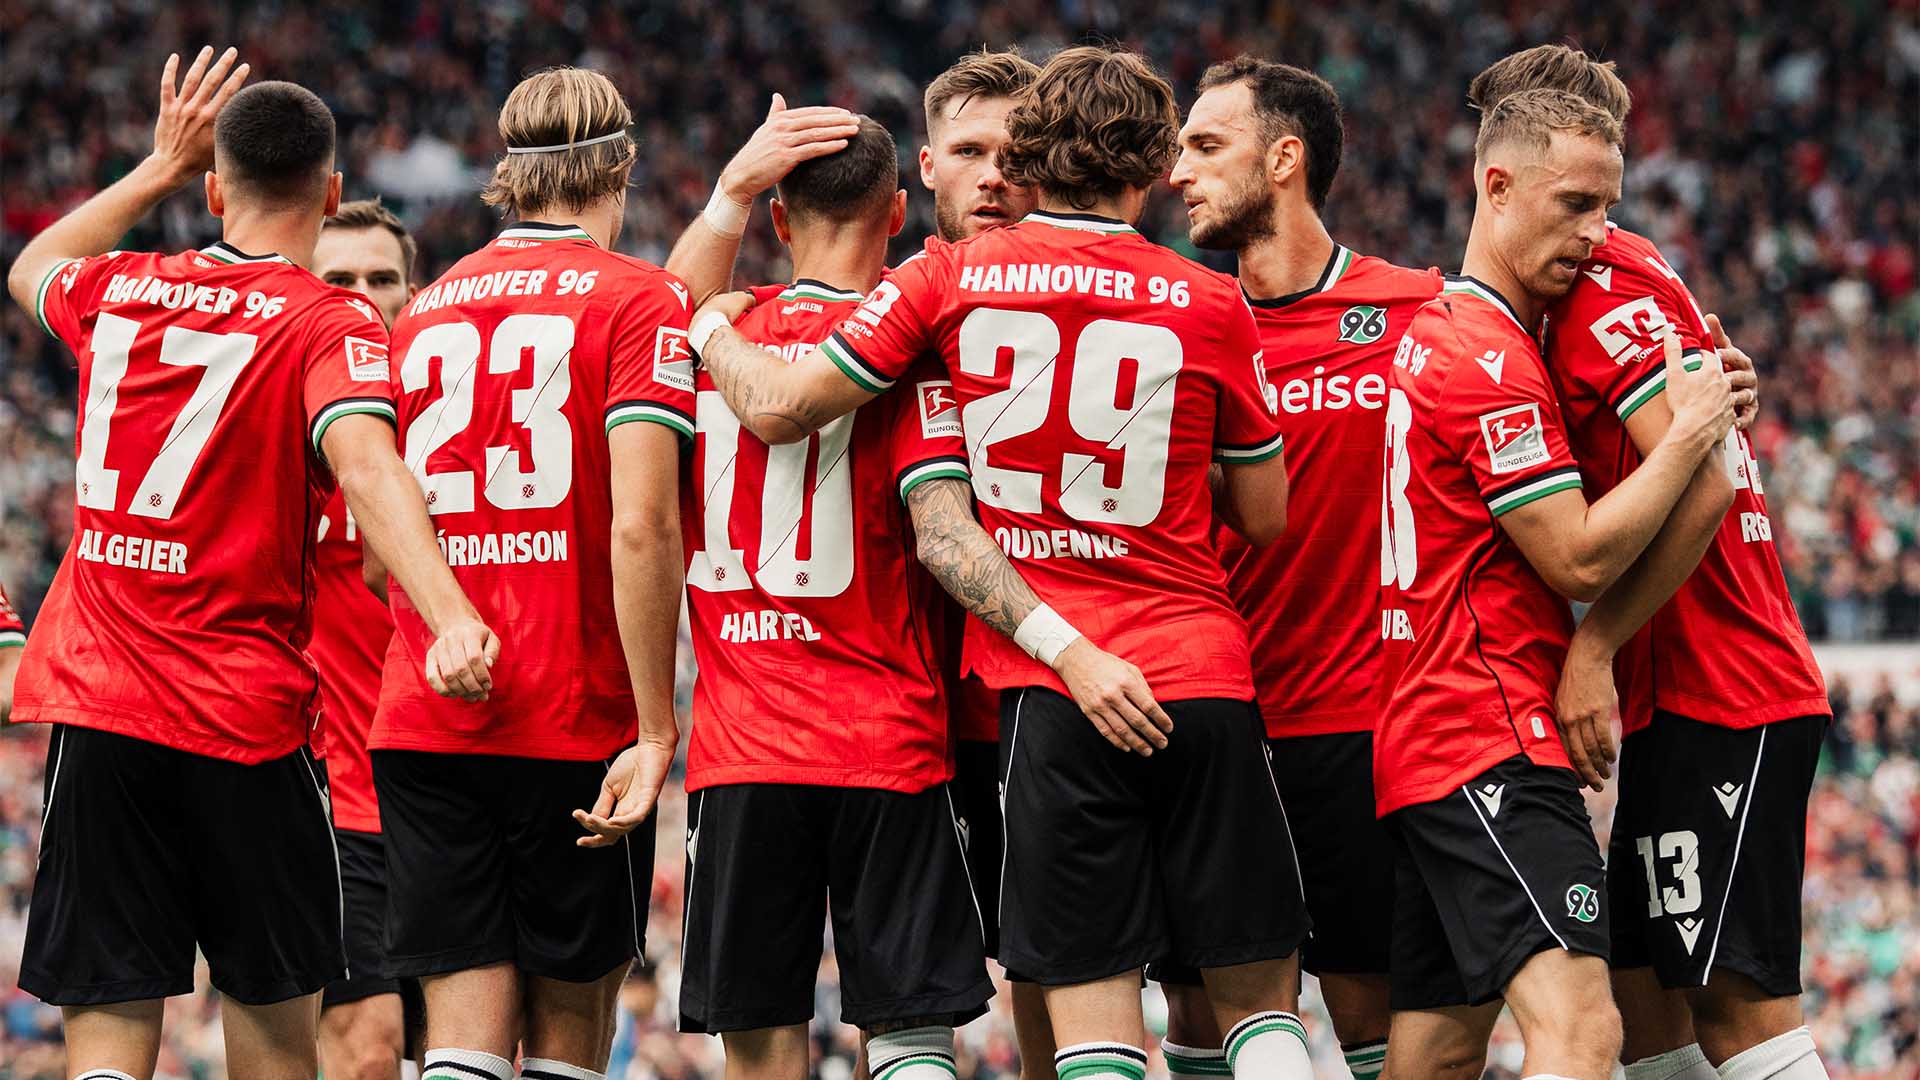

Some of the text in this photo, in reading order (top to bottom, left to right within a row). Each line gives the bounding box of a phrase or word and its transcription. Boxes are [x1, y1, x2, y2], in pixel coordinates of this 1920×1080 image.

[242, 291, 287, 319] 96
[409, 269, 599, 317] HANNOVER 96
[959, 263, 1190, 308] HANNOVER 96
[1337, 305, 1387, 344] 96
[76, 311, 258, 520] 17
[400, 314, 575, 515] 23
[959, 307, 1183, 527] 29
[1496, 450, 1545, 469] BUNDESLIGA
[686, 391, 854, 597] 10
[77, 529, 188, 574] ALGEIER
[720, 609, 821, 643] HARTEL
[1635, 830, 1702, 918] 13
[1566, 883, 1600, 922] 96
